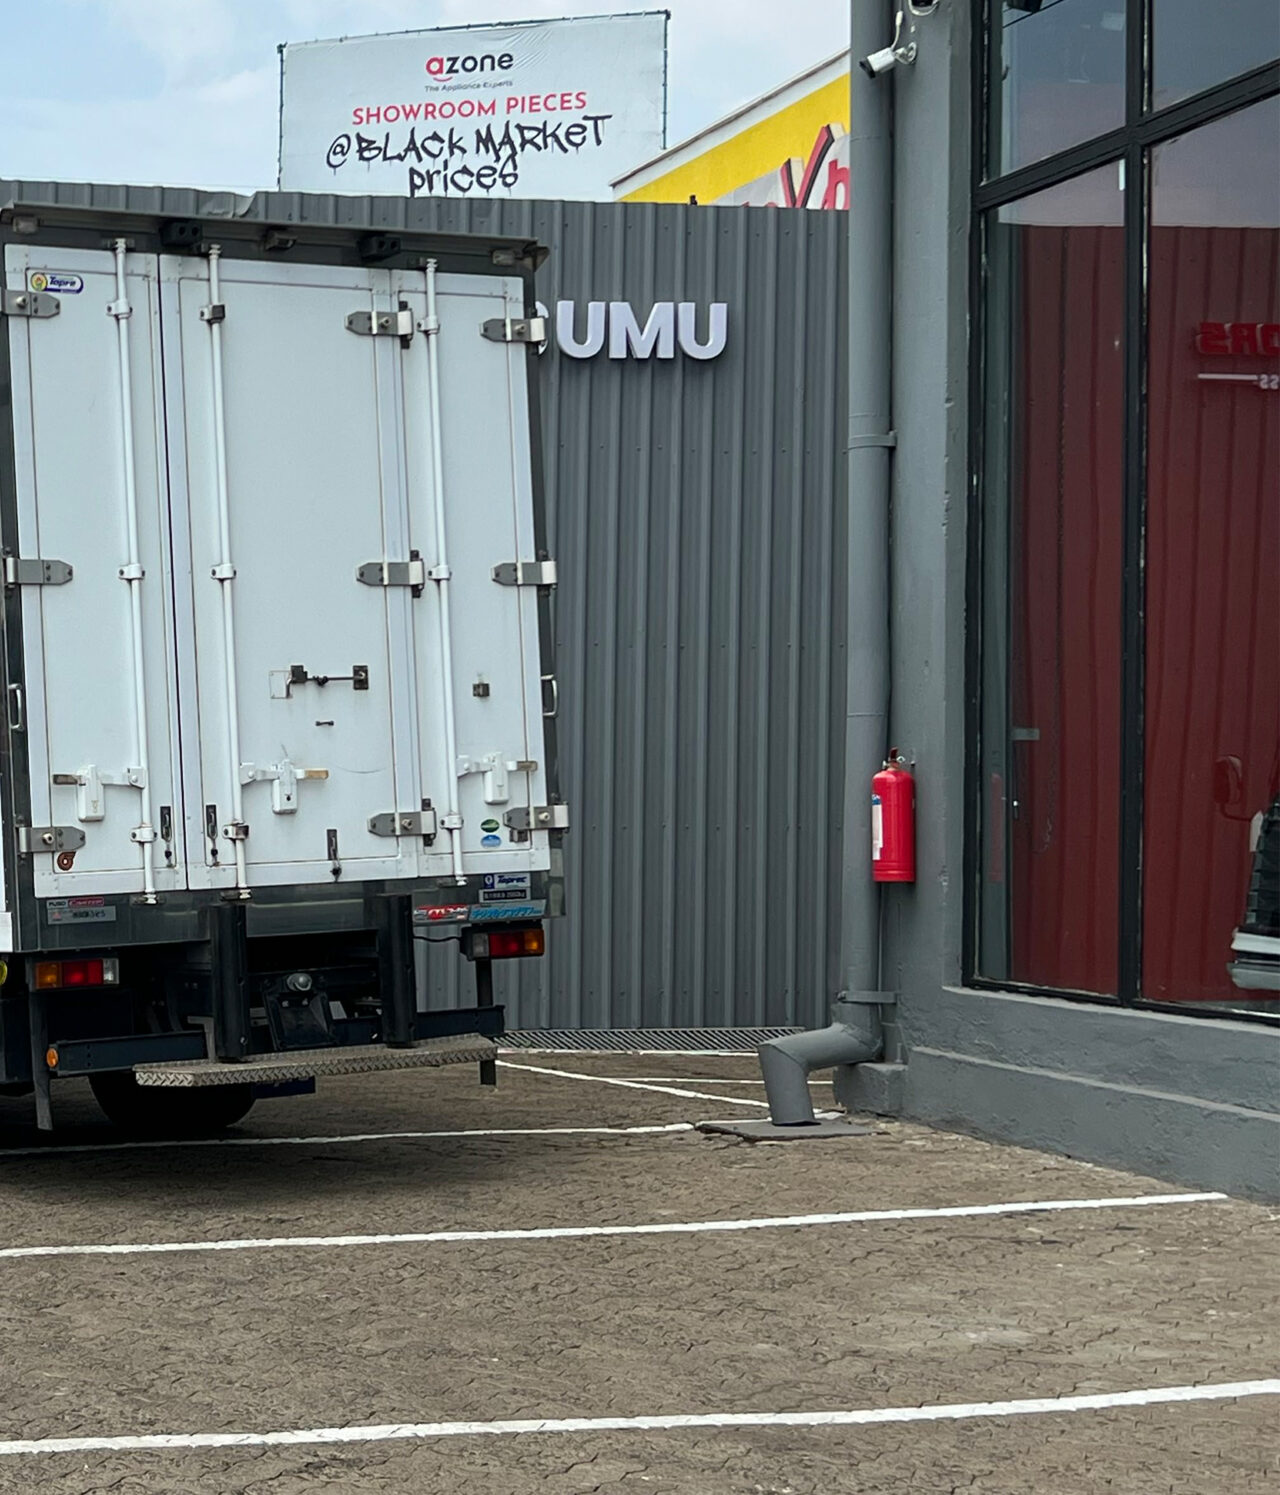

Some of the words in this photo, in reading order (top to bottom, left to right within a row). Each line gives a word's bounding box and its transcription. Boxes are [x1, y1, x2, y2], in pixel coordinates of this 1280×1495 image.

[426, 53, 514, 76] azone
[352, 99, 496, 125] SHOWROOM
[506, 91, 588, 115] PIECES
